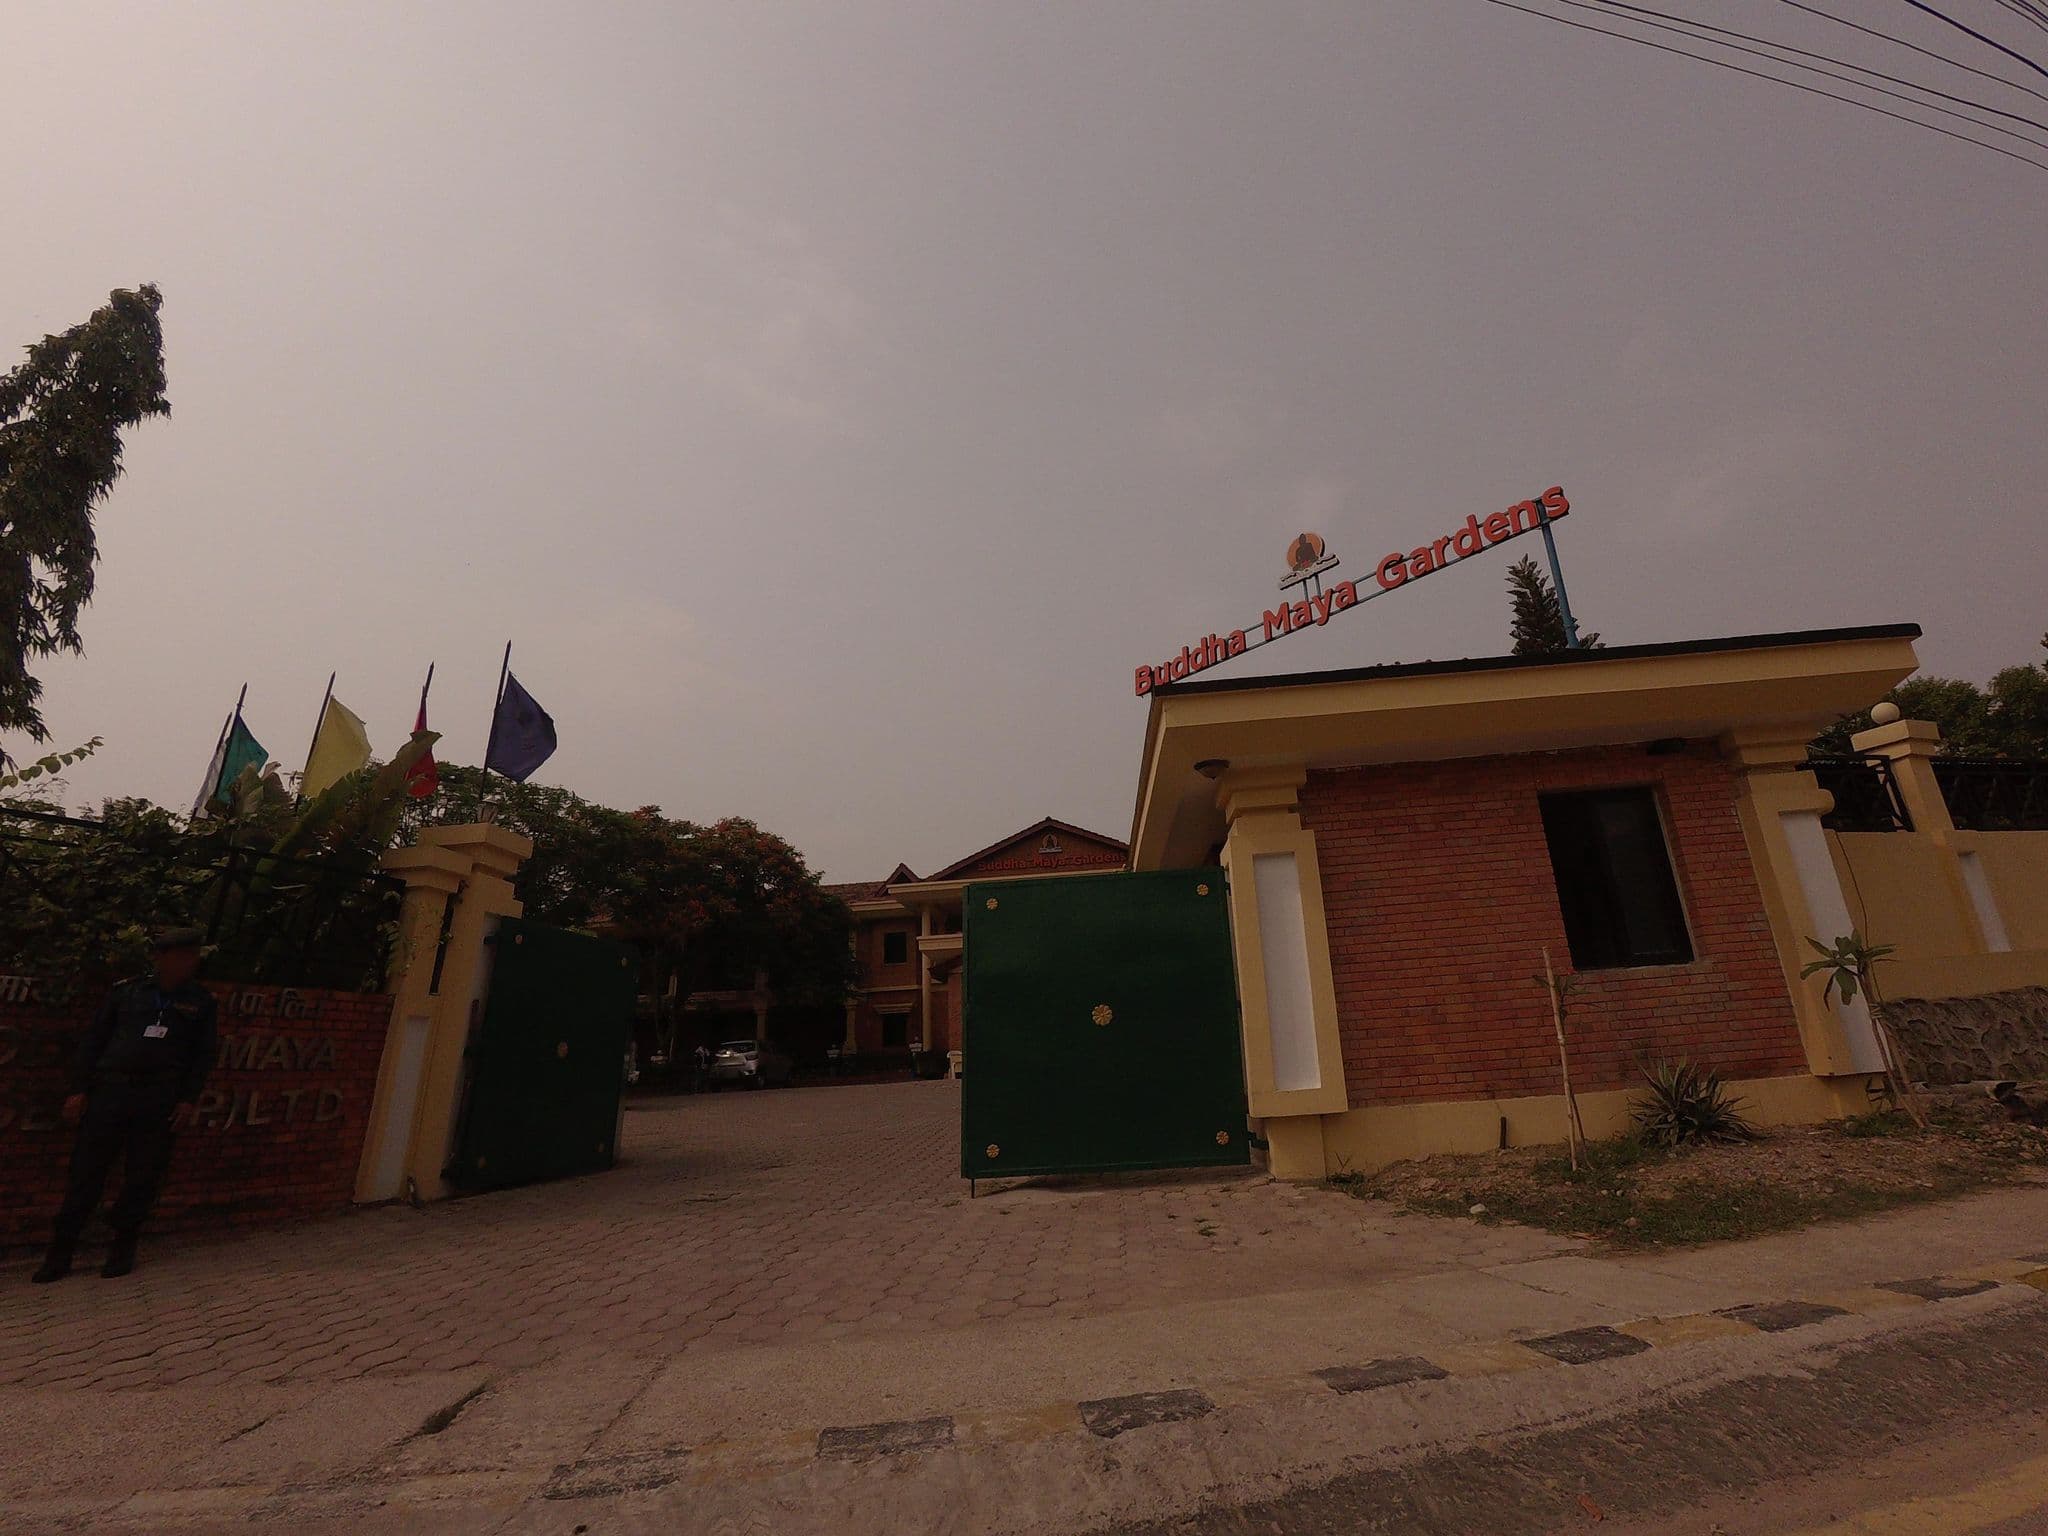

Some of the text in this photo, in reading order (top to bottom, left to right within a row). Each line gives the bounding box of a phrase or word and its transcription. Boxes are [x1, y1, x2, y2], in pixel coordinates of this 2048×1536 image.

[1135, 485, 1570, 697] Buddha Maya Gardens
[216, 1033, 337, 1072] MAYA
